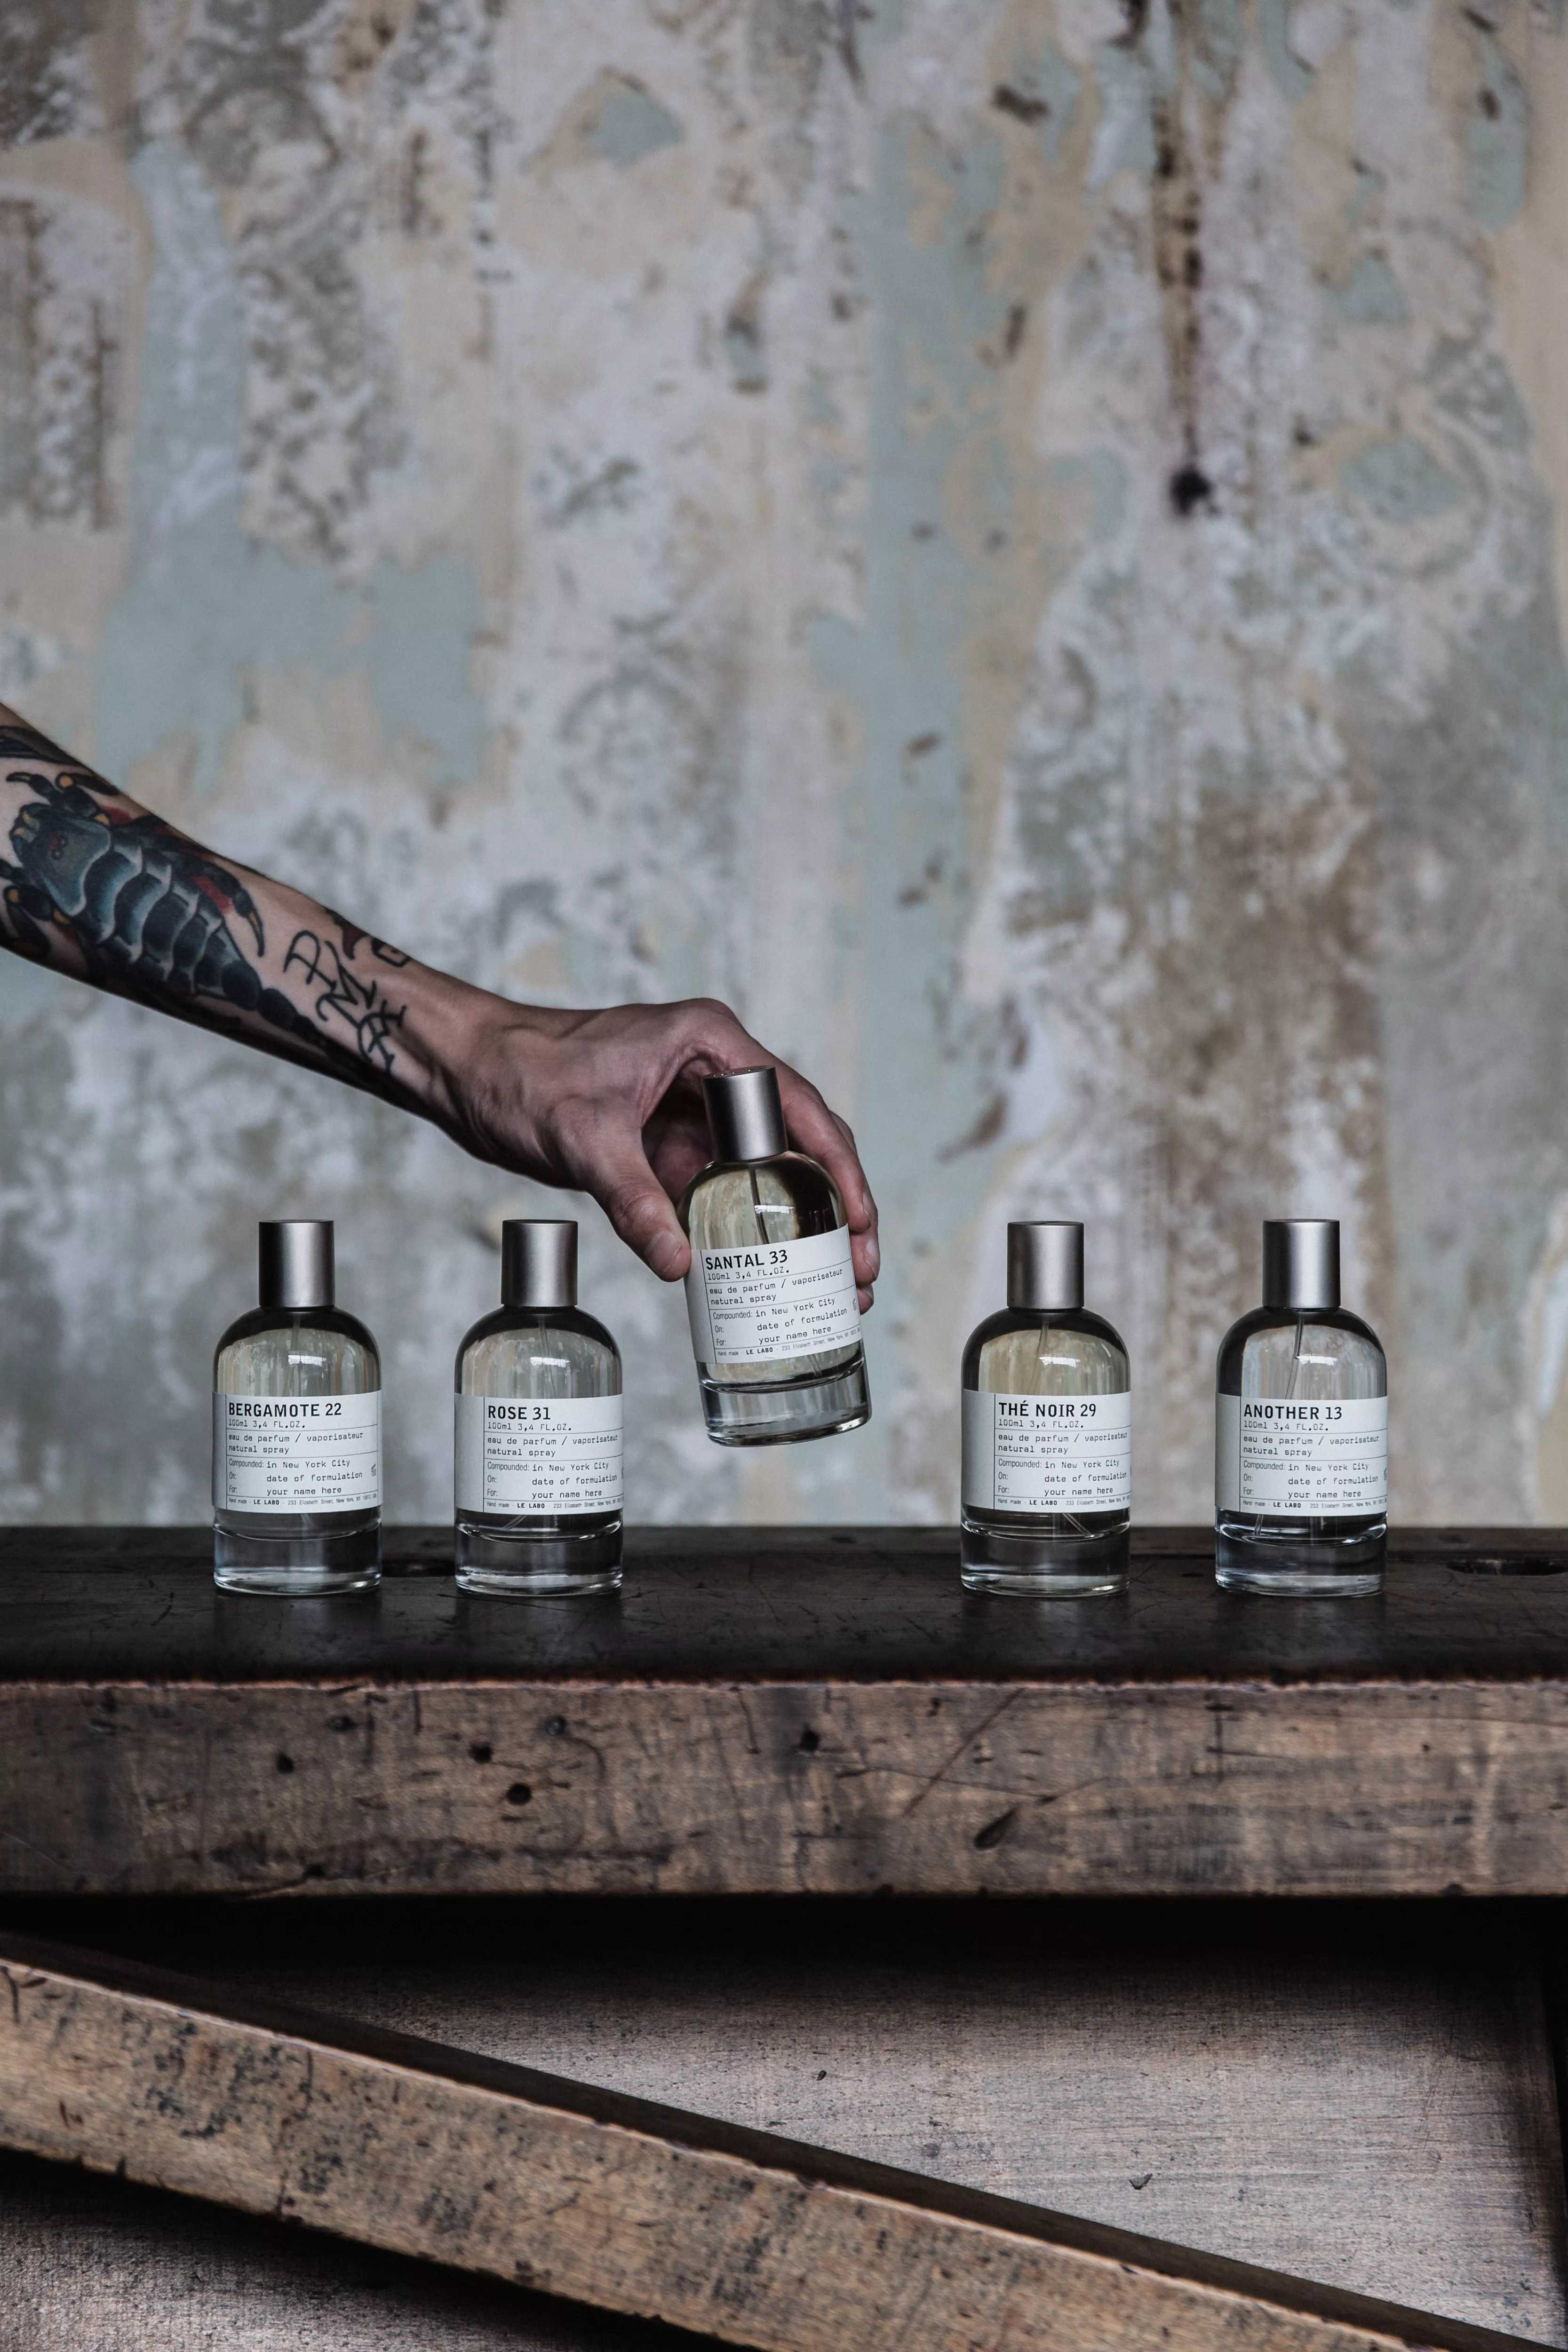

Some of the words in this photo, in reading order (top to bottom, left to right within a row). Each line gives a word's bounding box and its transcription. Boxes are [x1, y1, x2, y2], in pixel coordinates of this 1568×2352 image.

[705, 1253, 765, 1271] SANTAL
[769, 1249, 788, 1264] 33
[735, 1271, 751, 1279] 3,4
[742, 1283, 776, 1294] parfum
[792, 1269, 843, 1286] vaporisateur
[710, 1296, 744, 1305] natural
[749, 1294, 776, 1303] spray
[712, 1310, 753, 1321] Compounded:
[793, 1302, 814, 1311] York
[819, 1298, 835, 1307] City
[757, 1322, 779, 1331] date
[785, 1319, 795, 1327] of
[801, 1308, 847, 1324] formulation
[759, 1336, 780, 1346] your
[786, 1331, 809, 1341] name
[812, 1327, 831, 1335] here
[229, 1402, 320, 1417] BERGAMOTE
[325, 1403, 342, 1416] 22
[488, 1405, 527, 1420] ROSE
[533, 1407, 551, 1420] 31
[998, 1400, 1029, 1416] THÉ
[1036, 1404, 1075, 1417] NOIR
[1080, 1403, 1096, 1417] 29
[1243, 1404, 1319, 1420] ANOTHER
[1325, 1406, 1342, 1420] 13
[228, 1418, 248, 1427] 100ml
[253, 1420, 267, 1429] 3,4
[487, 1422, 512, 1430] 100ml
[518, 1423, 533, 1432] 3,4
[998, 1419, 1024, 1427] 100ml
[1030, 1420, 1046, 1429] 3,4
[1243, 1420, 1267, 1429] 100ml
[1274, 1422, 1289, 1431] 3,4
[257, 1435, 290, 1443] parfum
[307, 1432, 363, 1443] vaporisateur
[523, 1438, 557, 1446] parfum
[573, 1435, 618, 1445] vaporisateur
[1035, 1435, 1069, 1443] parfum
[1084, 1432, 1128, 1442] vaporisateur
[1329, 1436, 1379, 1446] vaporisateur
[1243, 1446, 1278, 1455] natural
[229, 1460, 264, 1469] Compounded:
[487, 1461, 529, 1471] Compounded:
[594, 1462, 609, 1470] City
[998, 1458, 1042, 1468] Compounded:
[1243, 1460, 1286, 1470] Compounded:
[311, 1471, 363, 1481] formulation
[487, 1475, 497, 1483] On:
[576, 1474, 617, 1484] formulation
[998, 1471, 1008, 1480] On:
[1088, 1471, 1127, 1481] formulation
[1333, 1475, 1378, 1485] formulation
[229, 1485, 238, 1493] For:
[487, 1488, 498, 1497] For:
[998, 1485, 1009, 1494] For:
[1243, 1486, 1254, 1495] For:
